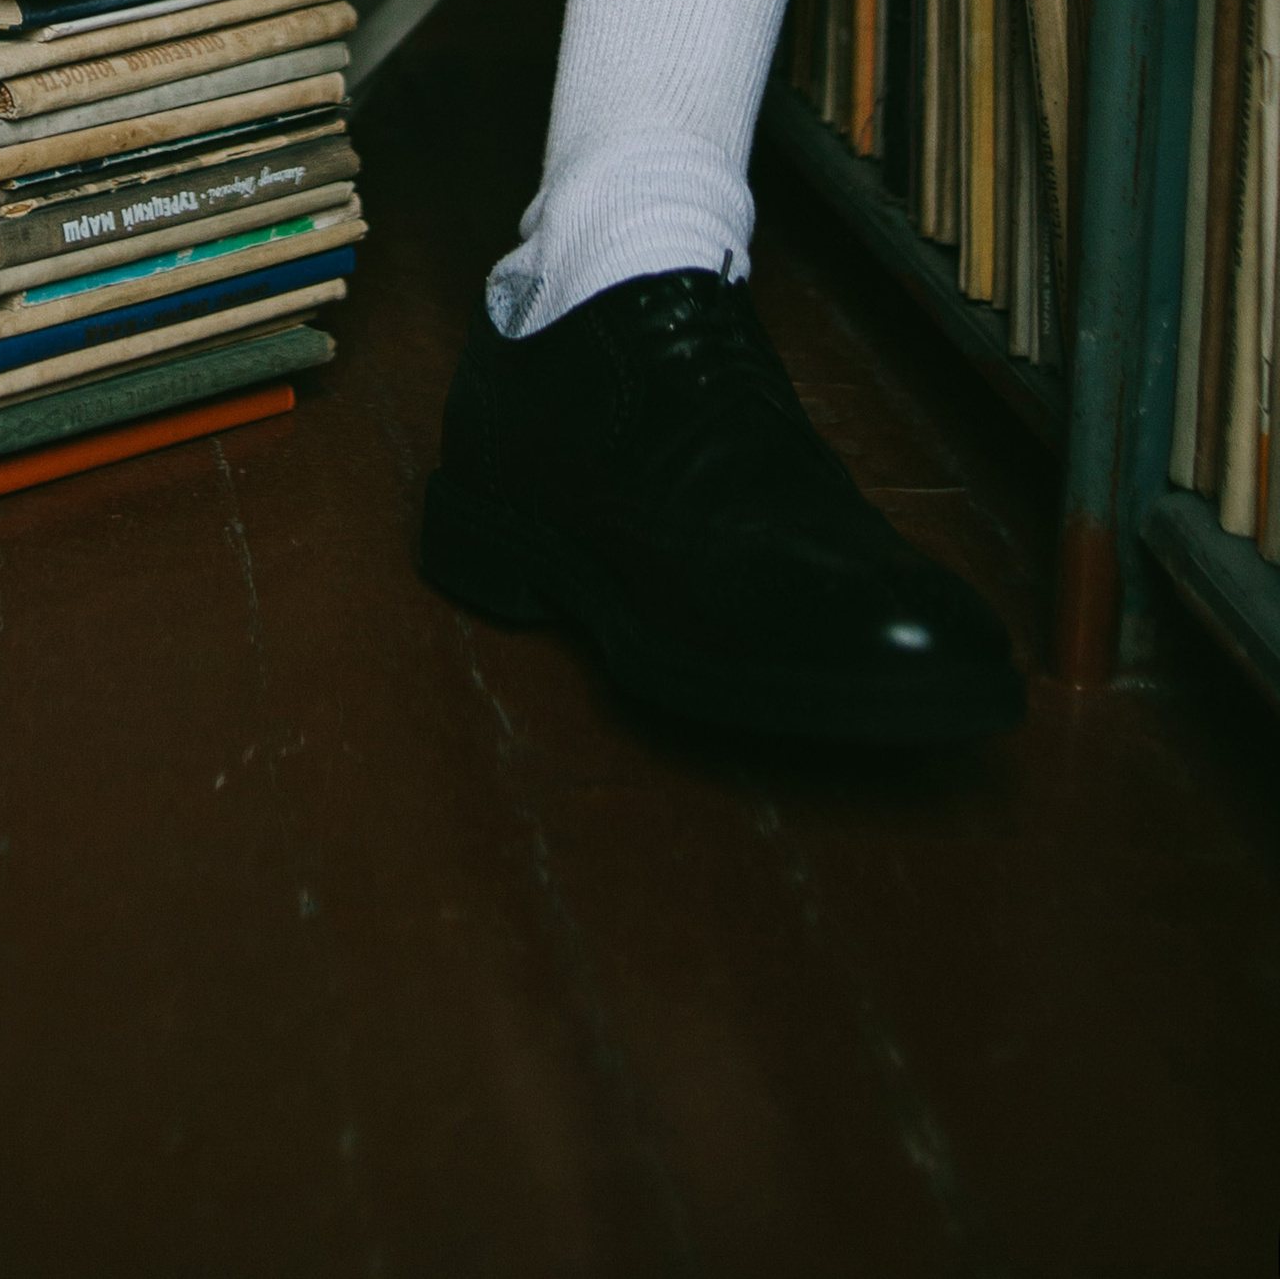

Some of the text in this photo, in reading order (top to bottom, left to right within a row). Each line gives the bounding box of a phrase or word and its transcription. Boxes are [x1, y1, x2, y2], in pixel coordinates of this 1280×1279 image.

[34, 36, 226, 93] ОПАЛЕННАЯ ЮНОСТЬ
[64, 210, 115, 243] МАРШ
[122, 190, 199, 231] ТУРЕЦКИЙ
